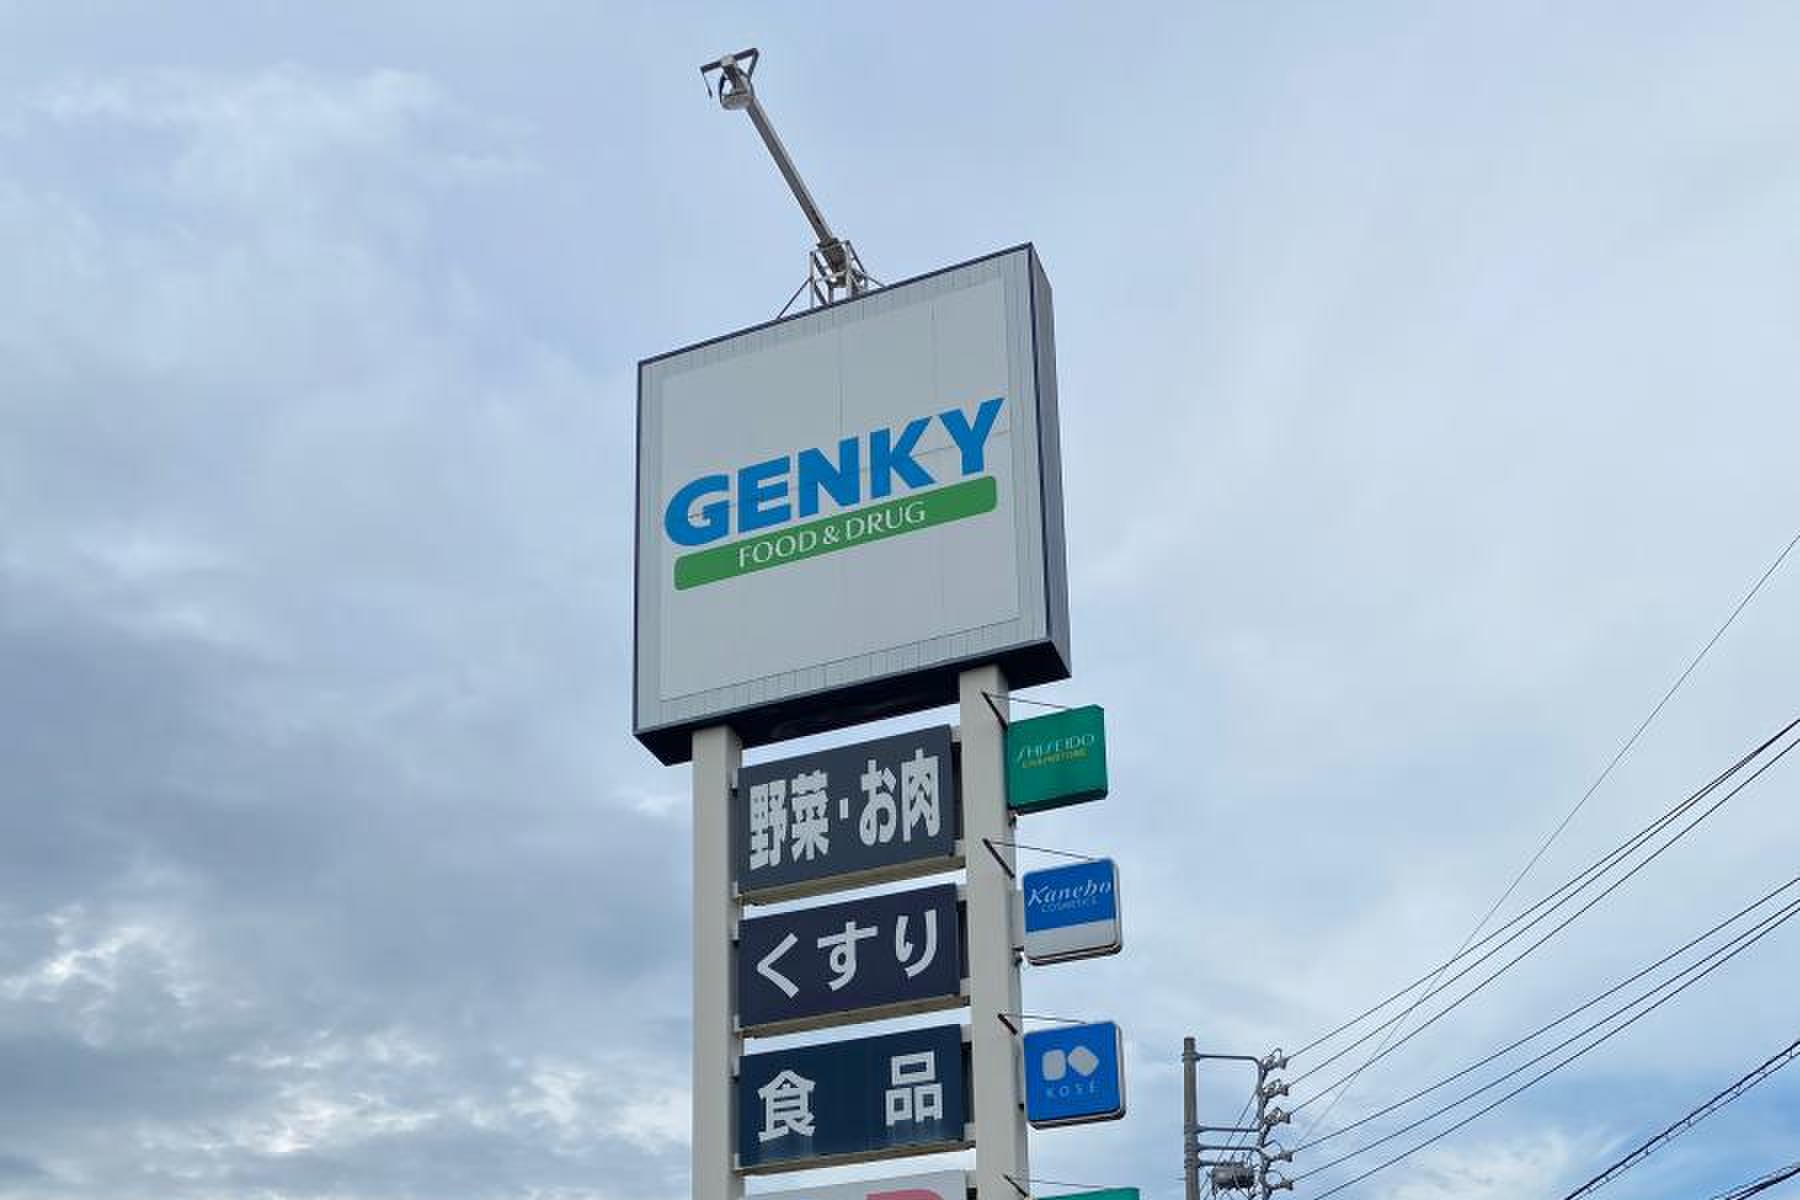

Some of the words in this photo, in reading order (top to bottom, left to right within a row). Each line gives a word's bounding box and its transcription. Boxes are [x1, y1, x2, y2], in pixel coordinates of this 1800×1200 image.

[664, 398, 1005, 547] GENKY
[738, 526, 818, 569] FOOD
[822, 524, 840, 545] &
[845, 501, 926, 542] DRUG
[749, 750, 940, 870] 野菜・お肉
[1027, 880, 1111, 907] Kanebo
[756, 908, 937, 1000] くすり
